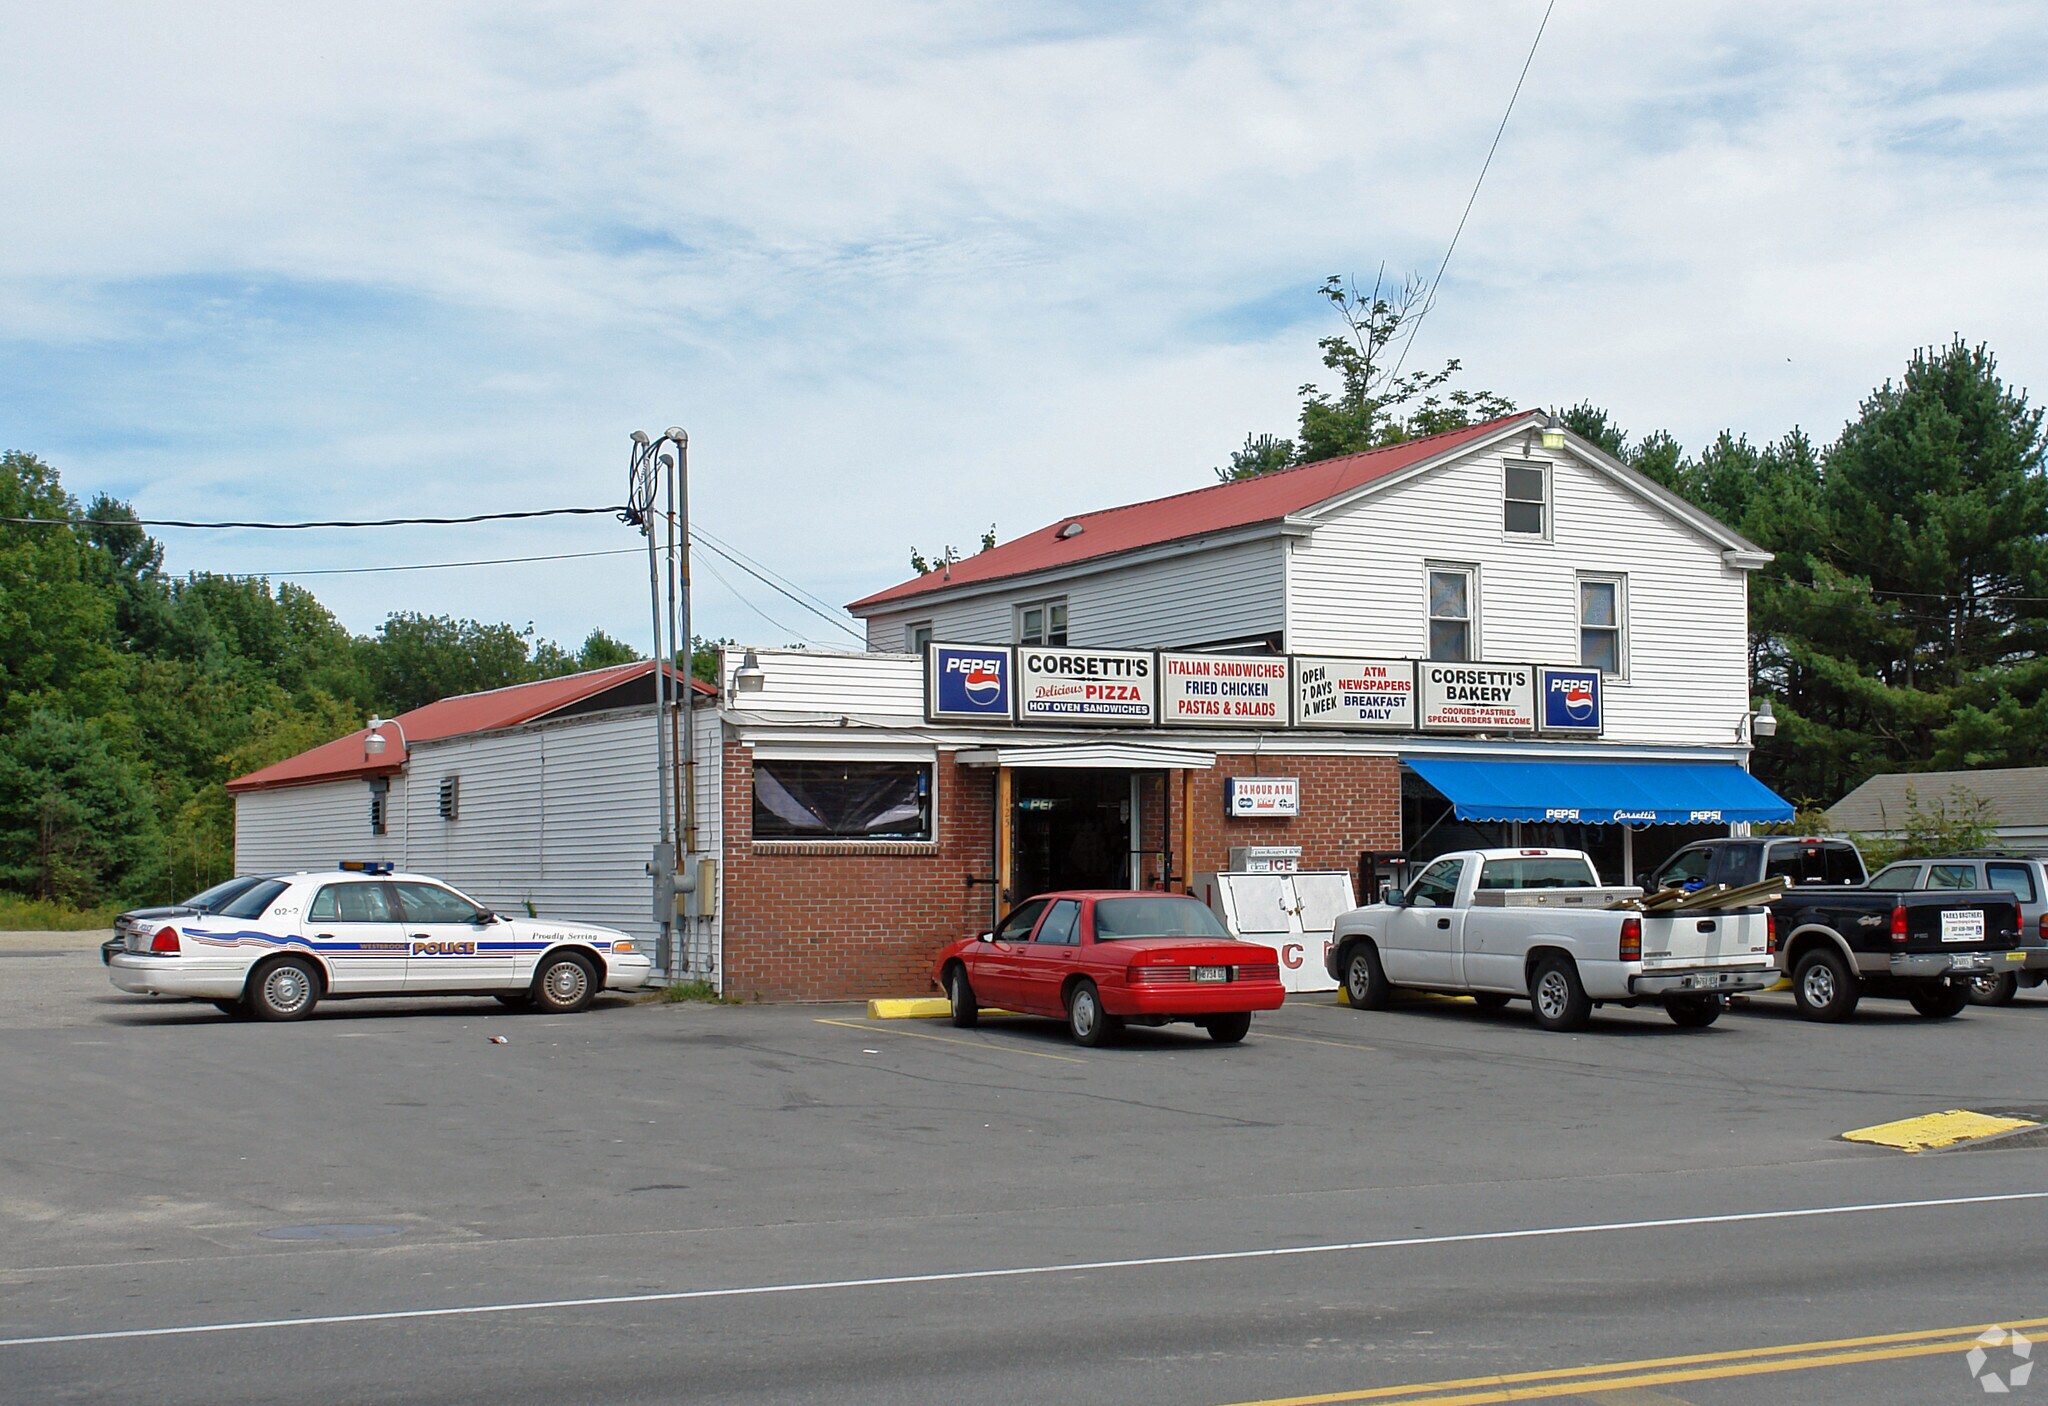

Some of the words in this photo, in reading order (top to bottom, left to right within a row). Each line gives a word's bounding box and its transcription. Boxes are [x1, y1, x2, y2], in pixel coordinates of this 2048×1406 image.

[945, 657, 1001, 674] PEPSI
[1027, 655, 1148, 677] CORSETTI'S
[1168, 660, 1210, 675] ITALIAN
[1214, 662, 1285, 678] SANDWICHES
[1363, 667, 1387, 677] ATM
[1302, 666, 1326, 684] OPEN
[1431, 669, 1526, 686] CORSETTI'S
[1185, 681, 1218, 695] FRIED
[1221, 682, 1268, 697] CHICKEN
[1302, 688, 1307, 700] 7
[1310, 681, 1333, 699] DAYS
[1338, 679, 1411, 691] NEWSPAPERS
[1550, 679, 1593, 693] PEPSI
[1035, 684, 1083, 699] Delicious
[1085, 685, 1141, 701] PIZZA
[1446, 686, 1511, 702] BAKERY
[1029, 702, 1051, 711] HOT
[1053, 703, 1080, 712] OVEN
[1083, 704, 1148, 714] SANDWICHES
[1178, 700, 1220, 715] PASTAS
[1223, 701, 1231, 715] &
[1235, 702, 1276, 717] SALADS
[1304, 703, 1310, 717] A
[1313, 696, 1338, 715] WEEK
[1344, 696, 1407, 707] BREAKFAST
[1360, 709, 1391, 719] DAILY
[1427, 715, 1459, 723] SPECIAL
[1461, 716, 1491, 724] ORDERS
[1494, 717, 1531, 725] WELCOME
[1239, 785, 1248, 794] 24
[1250, 785, 1272, 794] HOUR
[1275, 785, 1293, 794] ATM
[1546, 809, 1579, 819] PEPSI
[1690, 810, 1721, 820] PEPSI
[1250, 862, 1268, 870] clear
[1269, 859, 1293, 871] ICE
[274, 907, 299, 915] 02-2
[532, 932, 565, 940] Proudly
[567, 932, 598, 940] Serving
[412, 942, 476, 956] POLICE
